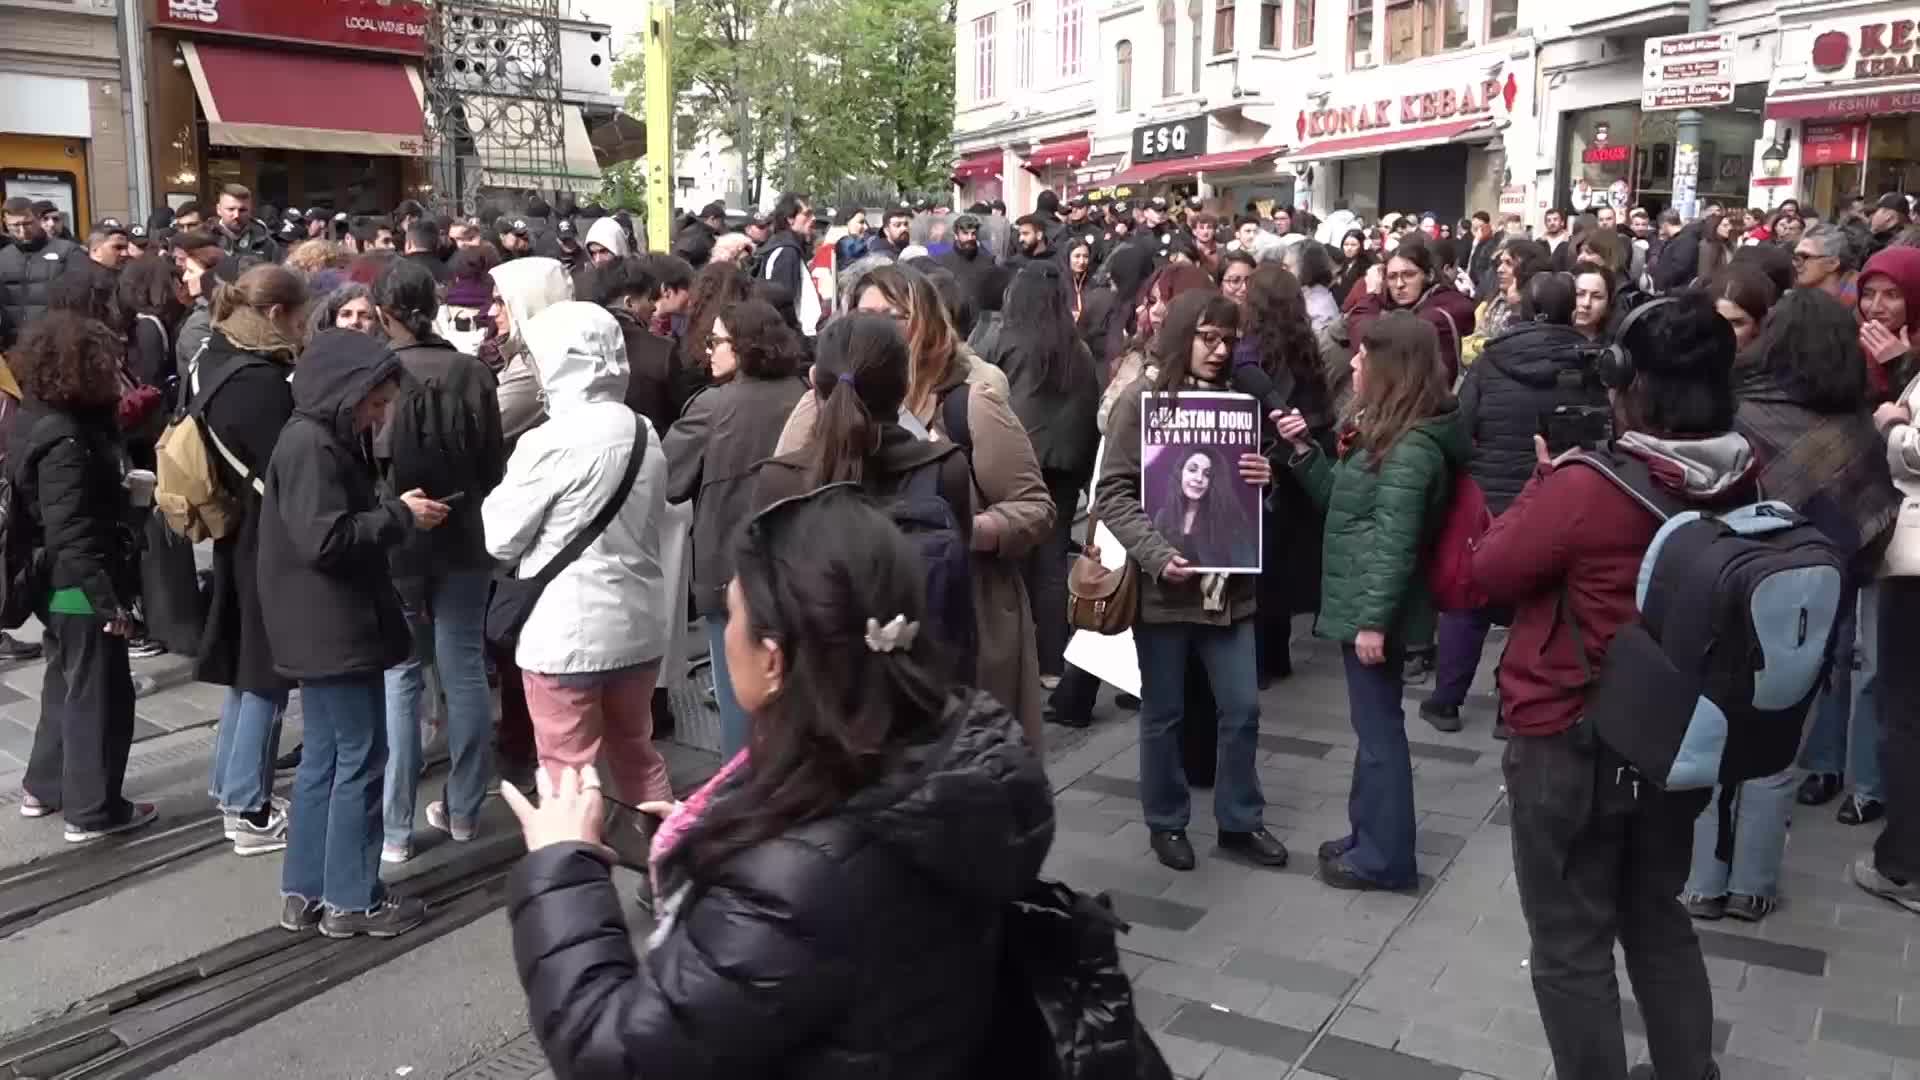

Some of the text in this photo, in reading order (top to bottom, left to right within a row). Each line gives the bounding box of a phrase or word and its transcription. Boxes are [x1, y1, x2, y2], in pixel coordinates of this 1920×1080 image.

[345, 16, 377, 32] LOCAL
[377, 20, 405, 34] WINE
[1858, 19, 1920, 57] KE
[1308, 80, 1501, 138] KONAK KEBAP
[1142, 124, 1187, 155] ESQ
[1218, 411, 1252, 430] DOKU
